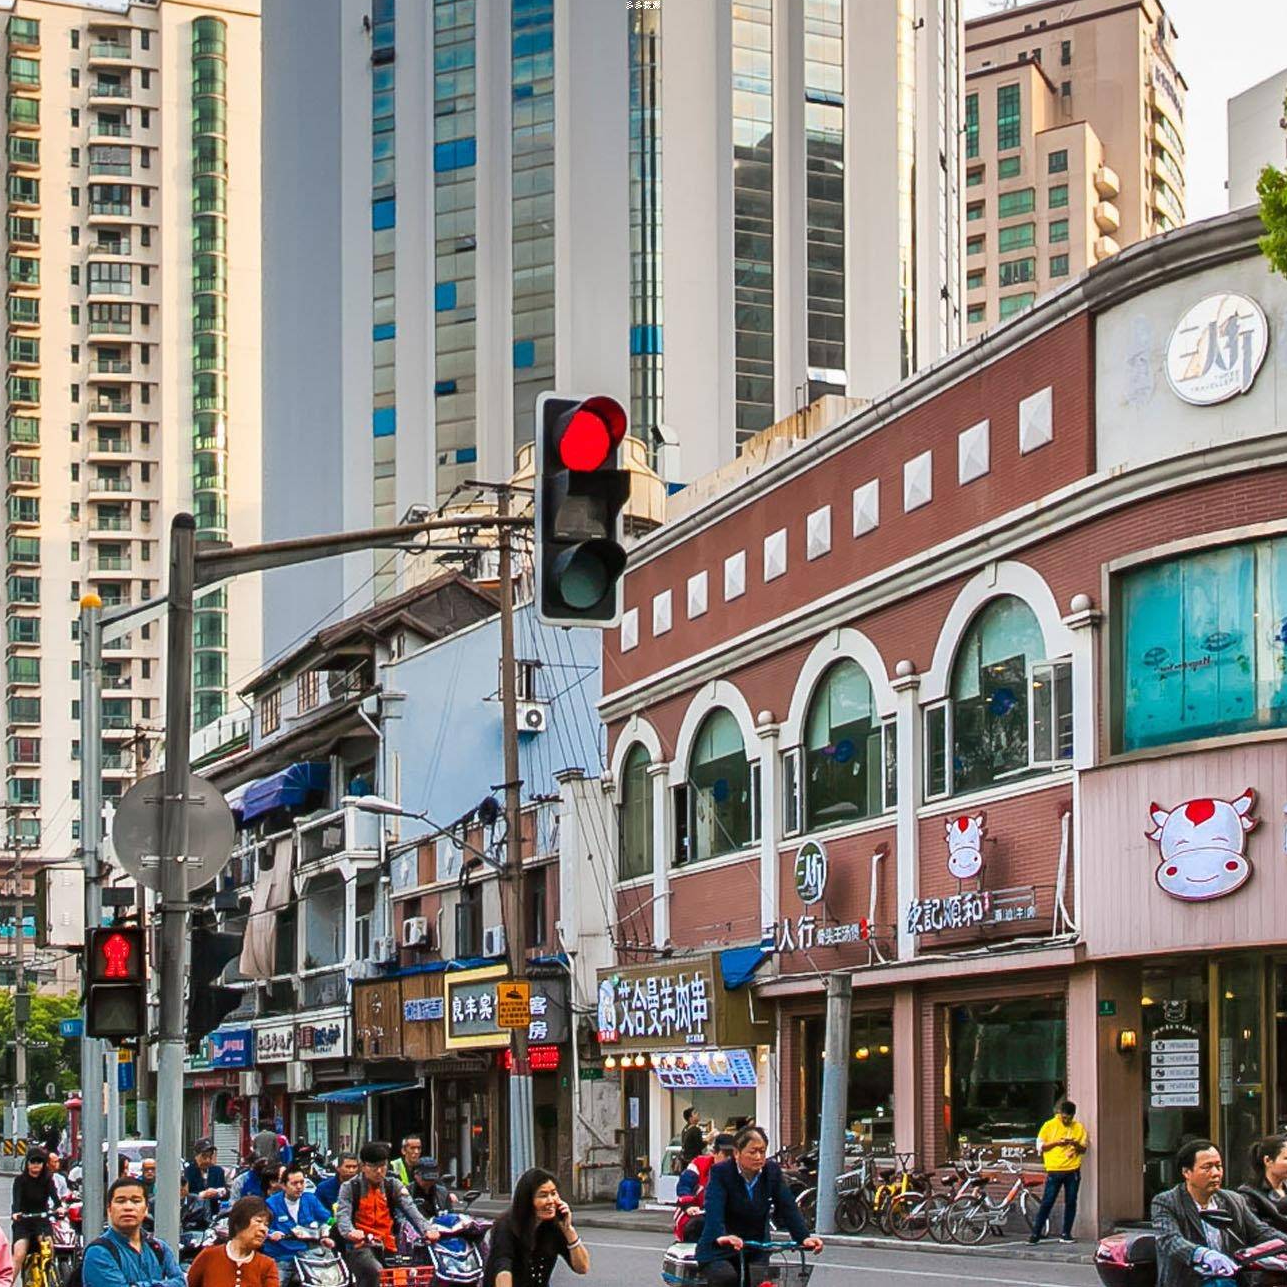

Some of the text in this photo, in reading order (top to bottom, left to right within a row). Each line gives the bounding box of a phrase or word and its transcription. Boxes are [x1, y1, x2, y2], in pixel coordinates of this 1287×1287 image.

[760, 915, 815, 951] 三人行
[452, 993, 498, 1022] 良丰宾
[528, 995, 548, 1040] 客房
[618, 971, 708, 1037] 艾合曼羊肉串
